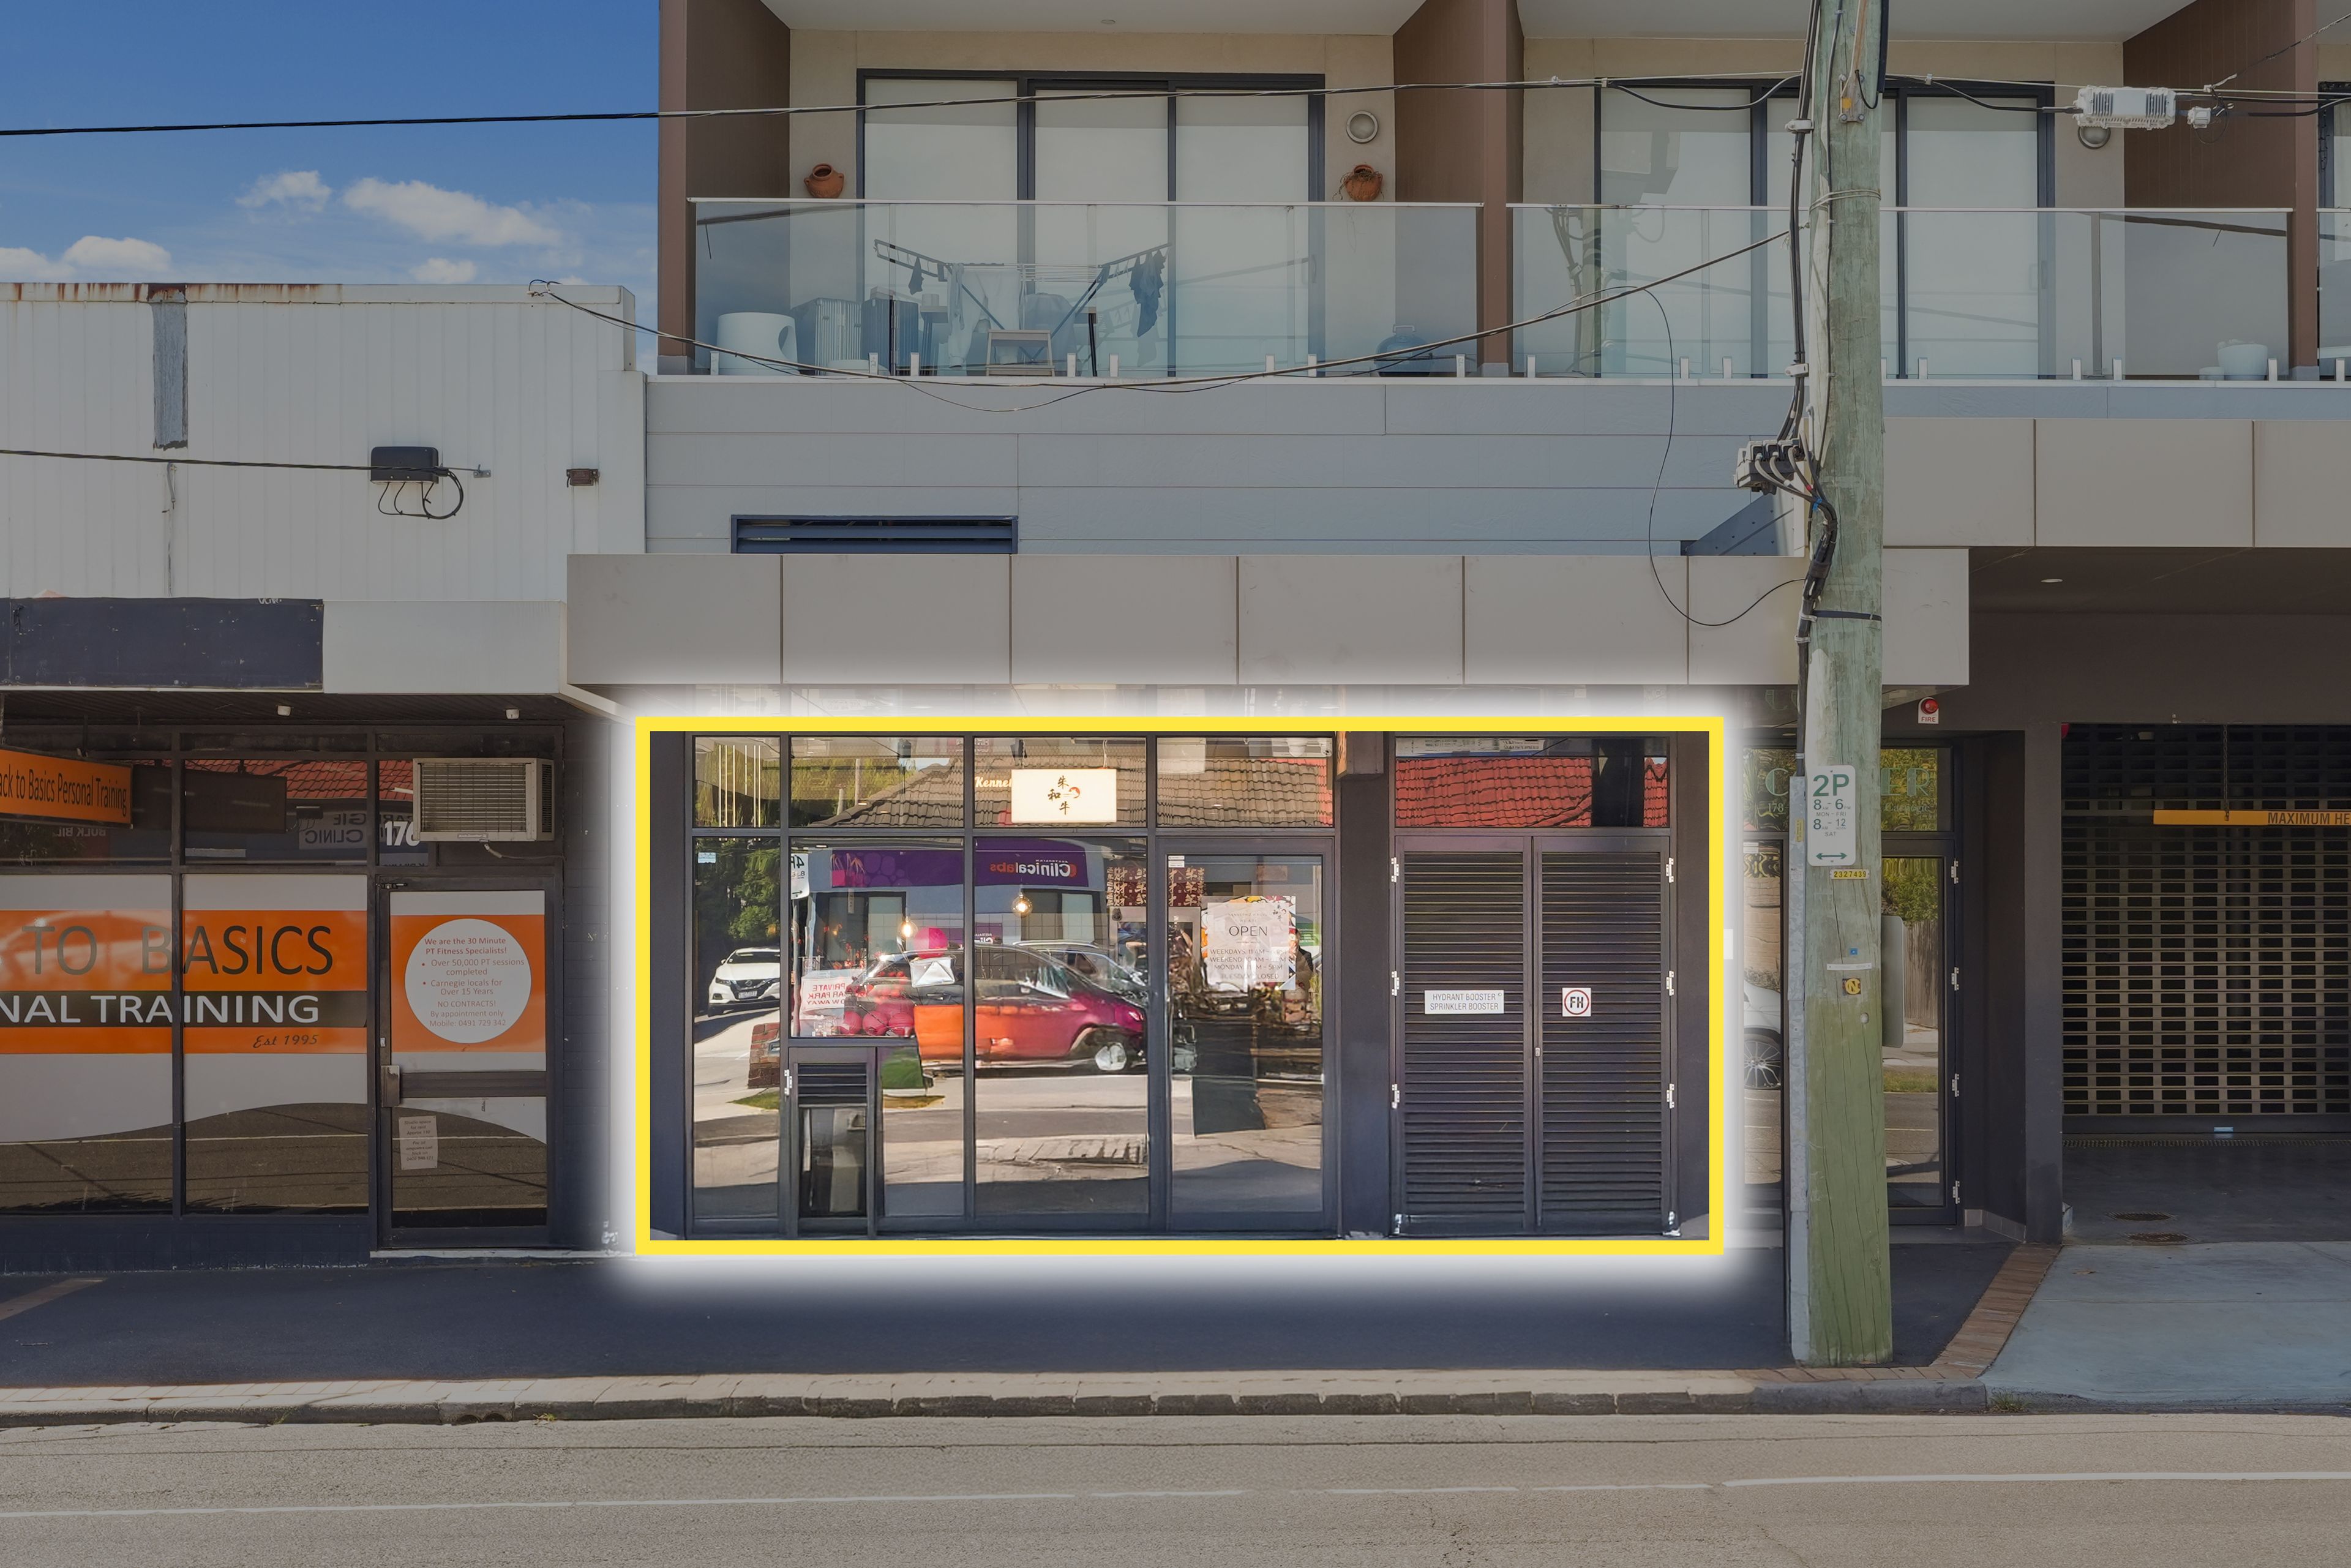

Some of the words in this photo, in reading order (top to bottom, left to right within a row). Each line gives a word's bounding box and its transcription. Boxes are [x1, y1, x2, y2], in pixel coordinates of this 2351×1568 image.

[1813, 774, 1850, 797] 2P
[16, 770, 25, 799] to
[29, 768, 55, 803] Basics
[58, 774, 94, 807] Personal
[96, 778, 127, 817] Training
[1835, 818, 1846, 827] 12
[2268, 812, 2330, 824] MAXIMUM
[1229, 925, 1267, 936] OPEN
[21, 925, 97, 975] TO
[142, 925, 334, 976] BASICS
[465, 947, 507, 956] Specialists!
[446, 968, 488, 977] completed
[430, 980, 465, 988] Carnegie
[1570, 996, 1584, 1008] FH
[91, 994, 319, 1024] TRAINING
[252, 1034, 278, 1049] Est
[283, 1034, 318, 1046] 1995
